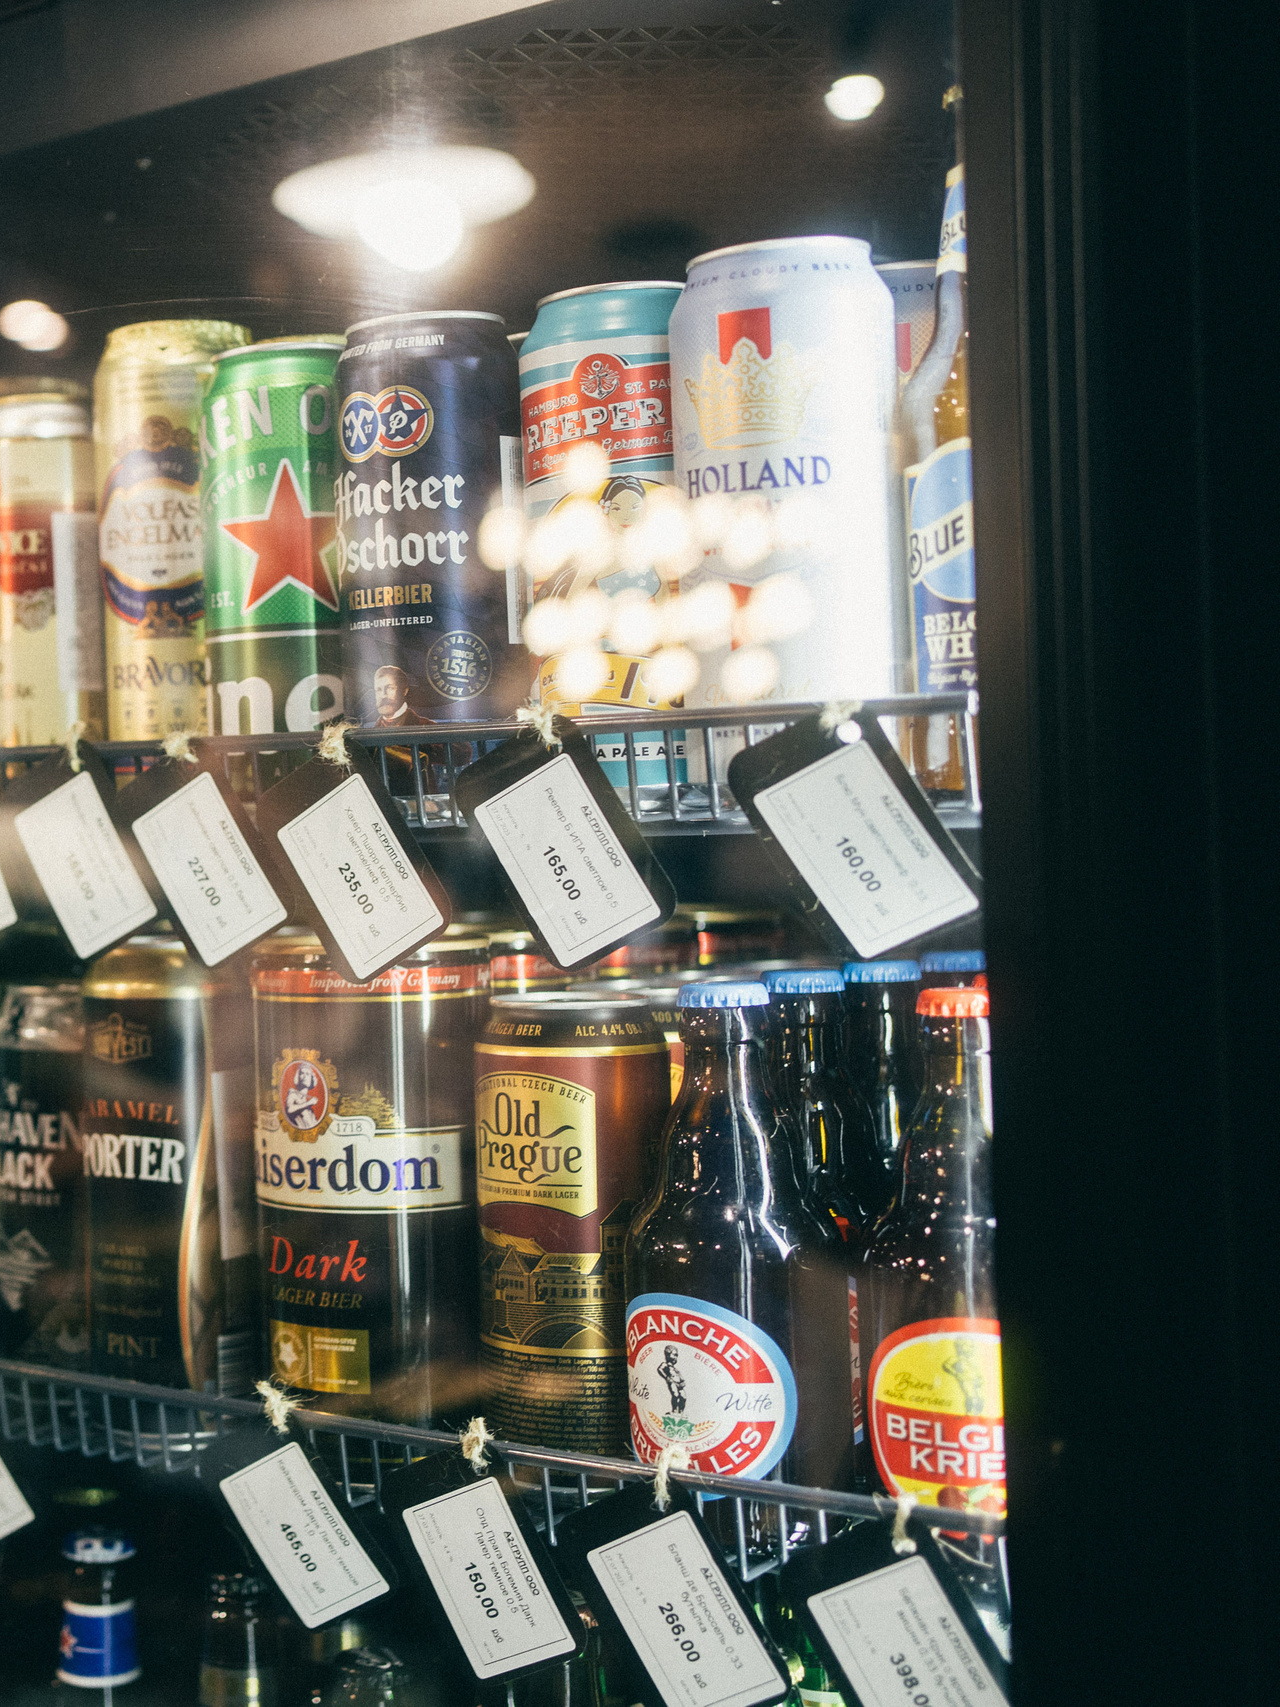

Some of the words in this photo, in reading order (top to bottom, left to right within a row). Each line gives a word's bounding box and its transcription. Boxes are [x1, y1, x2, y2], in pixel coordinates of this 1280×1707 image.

[394, 334, 445, 349] GERMANY
[527, 397, 668, 454] REEPER
[528, 393, 578, 419] HAMBURG
[624, 380, 646, 394] ST.
[602, 435, 659, 455] German
[334, 460, 466, 521] Hacker
[687, 456, 832, 500] HOLLAND
[349, 584, 433, 611] KELLERBIER
[441, 657, 477, 678] 1516
[342, 806, 363, 834] Хакер
[357, 833, 381, 866] Пшорр
[370, 821, 398, 861] А2-ГРУПП
[393, 860, 409, 881] ООО
[540, 786, 569, 824] Реепер
[567, 830, 587, 854] ИПА
[581, 854, 608, 892] светлое
[603, 891, 619, 909] 0,5
[579, 804, 610, 847] А2-ГРУПП
[604, 846, 622, 868] ООО
[184, 855, 223, 908] 227,00
[336, 861, 375, 916] 235,00
[537, 844, 583, 903] 165,00
[833, 832, 882, 897] 160,00
[515, 1024, 542, 1037] BEER
[575, 1024, 599, 1037] ALC.
[601, 1023, 625, 1037] 4.4%
[521, 1078, 554, 1093] CZECH
[559, 1086, 587, 1104] BEER
[336, 1123, 362, 1133] 1718
[478, 1126, 583, 1184] Prague
[501, 1187, 531, 1198] PREMIUM
[533, 1190, 553, 1199] DARK
[555, 1191, 579, 1200] LAGER
[268, 1236, 368, 1282] Dark
[319, 1292, 363, 1309] BIER
[627, 1314, 751, 1370] BLANCHE
[639, 1346, 654, 1364] BEER
[715, 1391, 773, 1412] Witte
[277, 1518, 318, 1576] 465,00
[334, 1527, 350, 1548] ООО
[471, 1529, 494, 1561] Лагер
[486, 1560, 510, 1597] темное
[501, 1529, 531, 1575] А2-ГРУПП
[524, 1574, 540, 1597] ООО
[459, 1560, 501, 1621] 150,00
[472, 1506, 490, 1529] Олд
[483, 1529, 505, 1560] Прага
[498, 1560, 526, 1602] Богемия
[518, 1601, 538, 1628] Дарк
[666, 1542, 691, 1579] Бланш
[685, 1578, 698, 1594] де
[694, 1592, 728, 1646] Брюссель
[699, 1564, 732, 1614] А2-ГРУПП
[726, 1612, 745, 1637] ООО
[656, 1599, 701, 1666] 266,00
